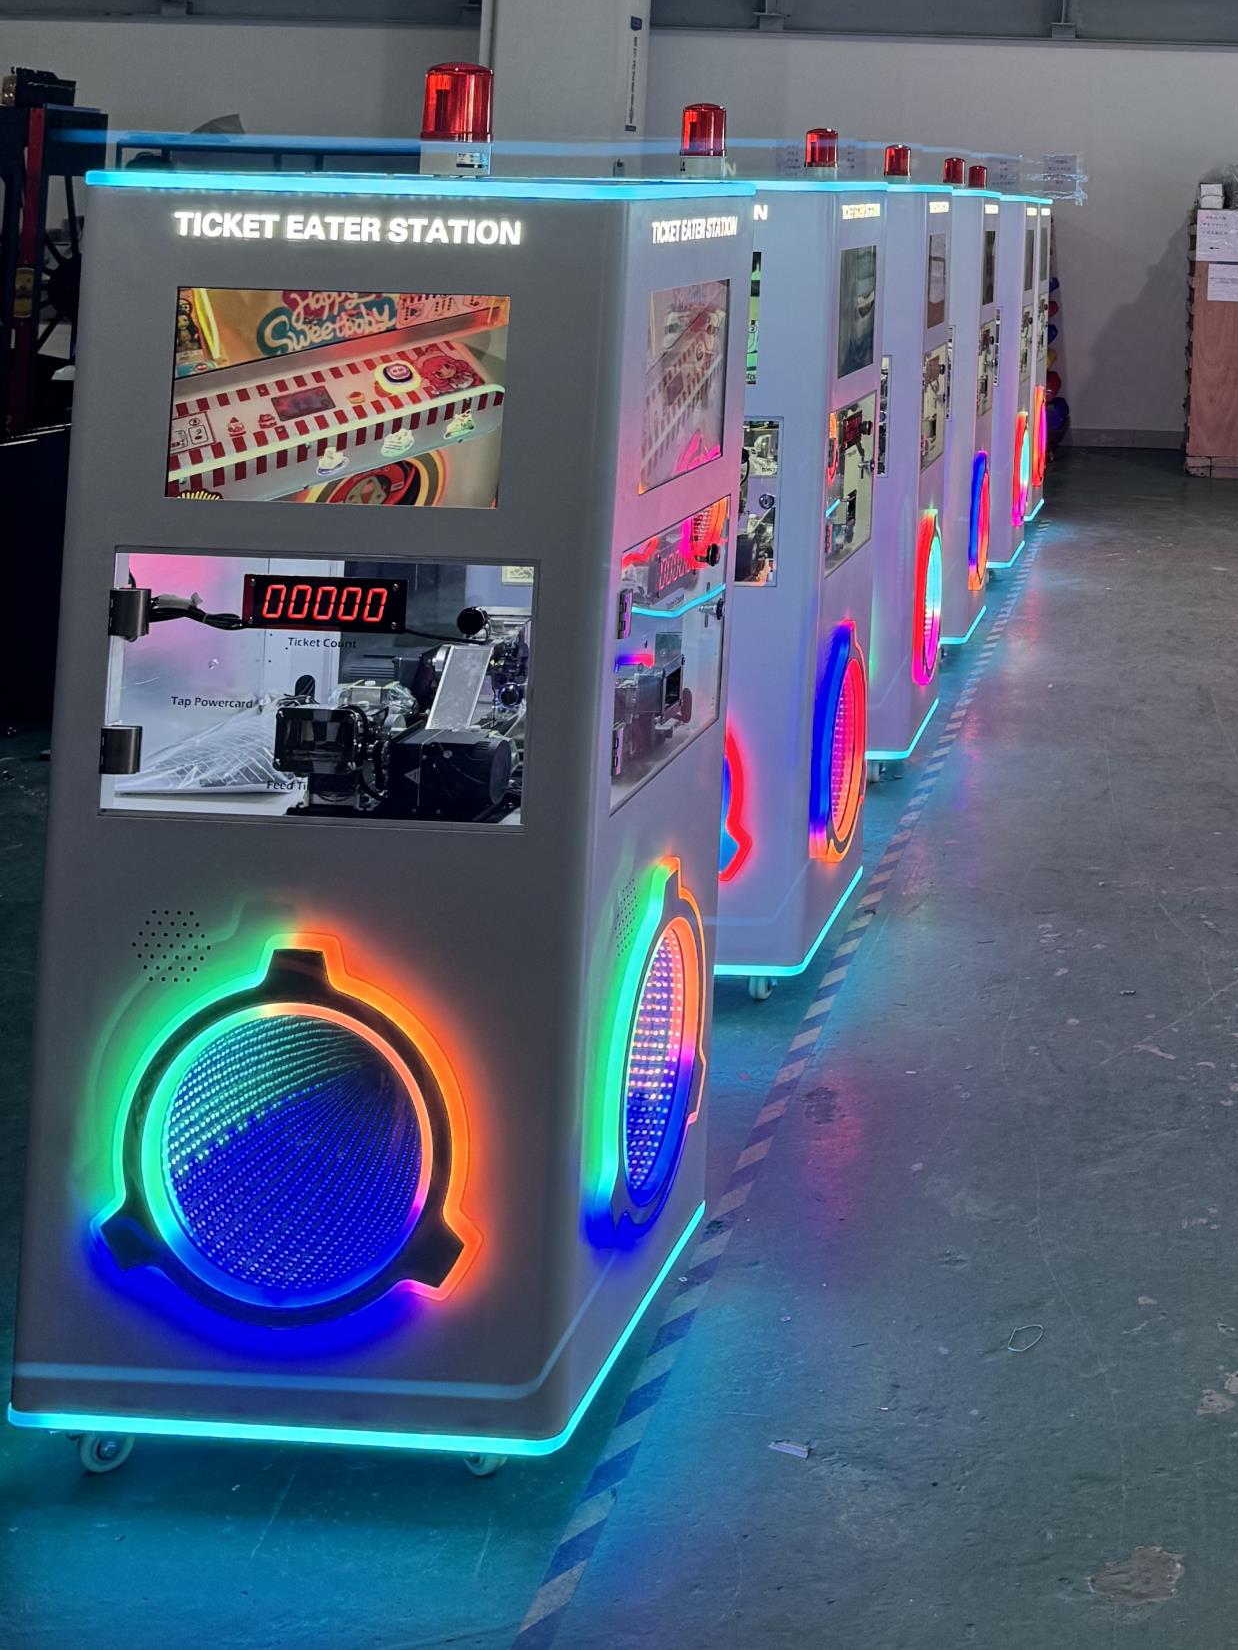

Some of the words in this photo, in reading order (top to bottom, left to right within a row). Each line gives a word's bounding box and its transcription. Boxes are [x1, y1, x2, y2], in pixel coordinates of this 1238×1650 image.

[174, 211, 280, 239] TICKET
[285, 215, 381, 242] EATER
[387, 217, 521, 245] STATION
[652, 219, 681, 244] TICKET
[681, 217, 706, 241] EATER
[706, 215, 738, 238] STATION
[261, 583, 388, 623] 00000
[287, 637, 321, 648] Ticket
[323, 638, 357, 649] Count
[170, 696, 192, 710] Tap
[194, 696, 254, 709] Powercard
[266, 780, 294, 790] Feed
